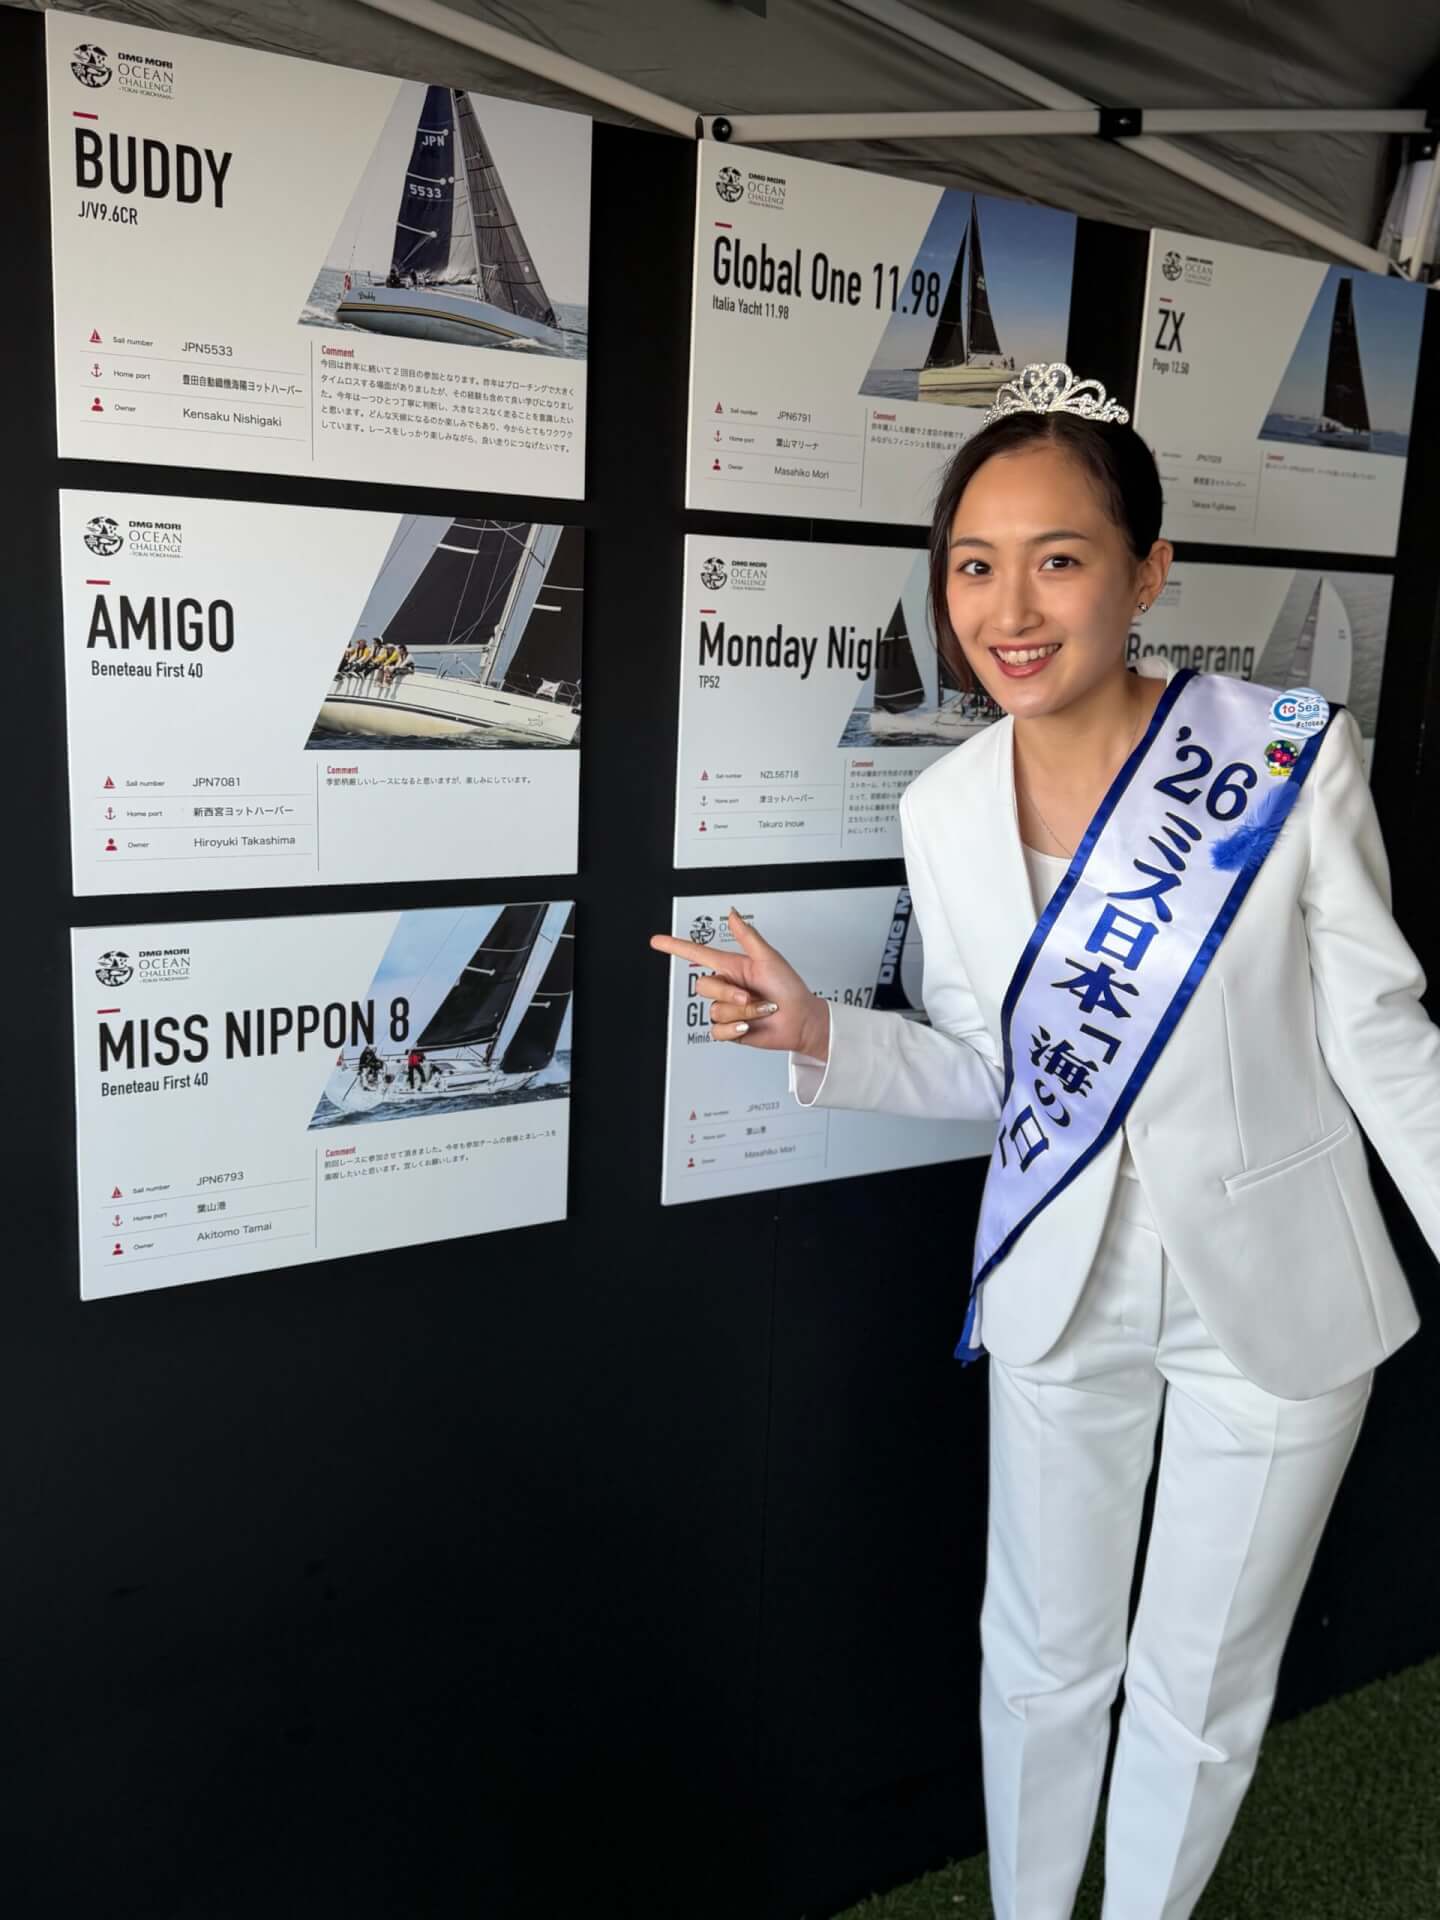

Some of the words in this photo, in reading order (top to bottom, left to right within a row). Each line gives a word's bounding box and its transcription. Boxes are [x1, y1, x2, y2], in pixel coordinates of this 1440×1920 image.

[118, 52, 143, 63] DMG
[145, 57, 173, 69] MORI
[118, 63, 173, 83] OCEAN
[118, 77, 172, 93] CHALLENGE
[422, 135, 445, 147] JPN
[75, 127, 232, 208] BUDDY
[409, 183, 442, 199] 5533
[748, 181, 786, 197] OCEAN
[78, 200, 138, 225] J/V9.6CR
[713, 236, 801, 298] Global
[811, 252, 862, 306] One
[873, 262, 941, 318] 11.98
[712, 295, 735, 313] Italia
[738, 298, 762, 317] Yacht
[765, 303, 789, 320] 11.98
[1155, 308, 1185, 353] ZX
[112, 336, 125, 345] Sail
[127, 337, 153, 347] number
[182, 341, 233, 357] JPN5533
[321, 345, 354, 358] Comment
[113, 370, 134, 379] Home
[136, 372, 151, 381] port
[114, 404, 137, 413] Owner
[183, 408, 230, 423] Kensaku
[233, 412, 282, 428] Nishigaki
[777, 411, 811, 424] JPN6791
[774, 466, 810, 478] Masahiko
[812, 467, 829, 480] Mori
[154, 522, 182, 530] MORI
[129, 530, 182, 543] OCEAN
[130, 543, 182, 552] CHALLENGE
[731, 569, 767, 578] OCEAN
[86, 594, 234, 653] AMIGO
[699, 621, 818, 681] Monday
[827, 626, 903, 681] Nigh
[91, 660, 151, 677] Beneteau
[156, 661, 184, 678] First
[188, 663, 203, 679] 40
[699, 675, 720, 689] TP52
[1282, 705, 1295, 714] to
[1297, 702, 1320, 713] Sea
[327, 766, 359, 774] Comment
[125, 779, 138, 787] Sail
[192, 777, 240, 787] JPN7081
[148, 810, 163, 818] port
[193, 806, 294, 817] 新西宮ヨットハーバー
[758, 820, 783, 829] Takuro
[194, 836, 238, 849] Hiroyuki
[241, 835, 296, 846] Takashima
[878, 920, 906, 984] DMG
[139, 957, 191, 970] OCEAN
[139, 968, 189, 977] CHALLENGE
[99, 1013, 209, 1072] MISS
[225, 999, 375, 1060] NIPPON
[390, 996, 409, 1043] 8
[101, 1075, 159, 1097] Beneteau
[163, 1072, 190, 1091] First
[194, 1071, 208, 1087] 40
[196, 1171, 244, 1186] JPN6793
[197, 1227, 240, 1242] Akitomo
[243, 1222, 272, 1234] Tamai
